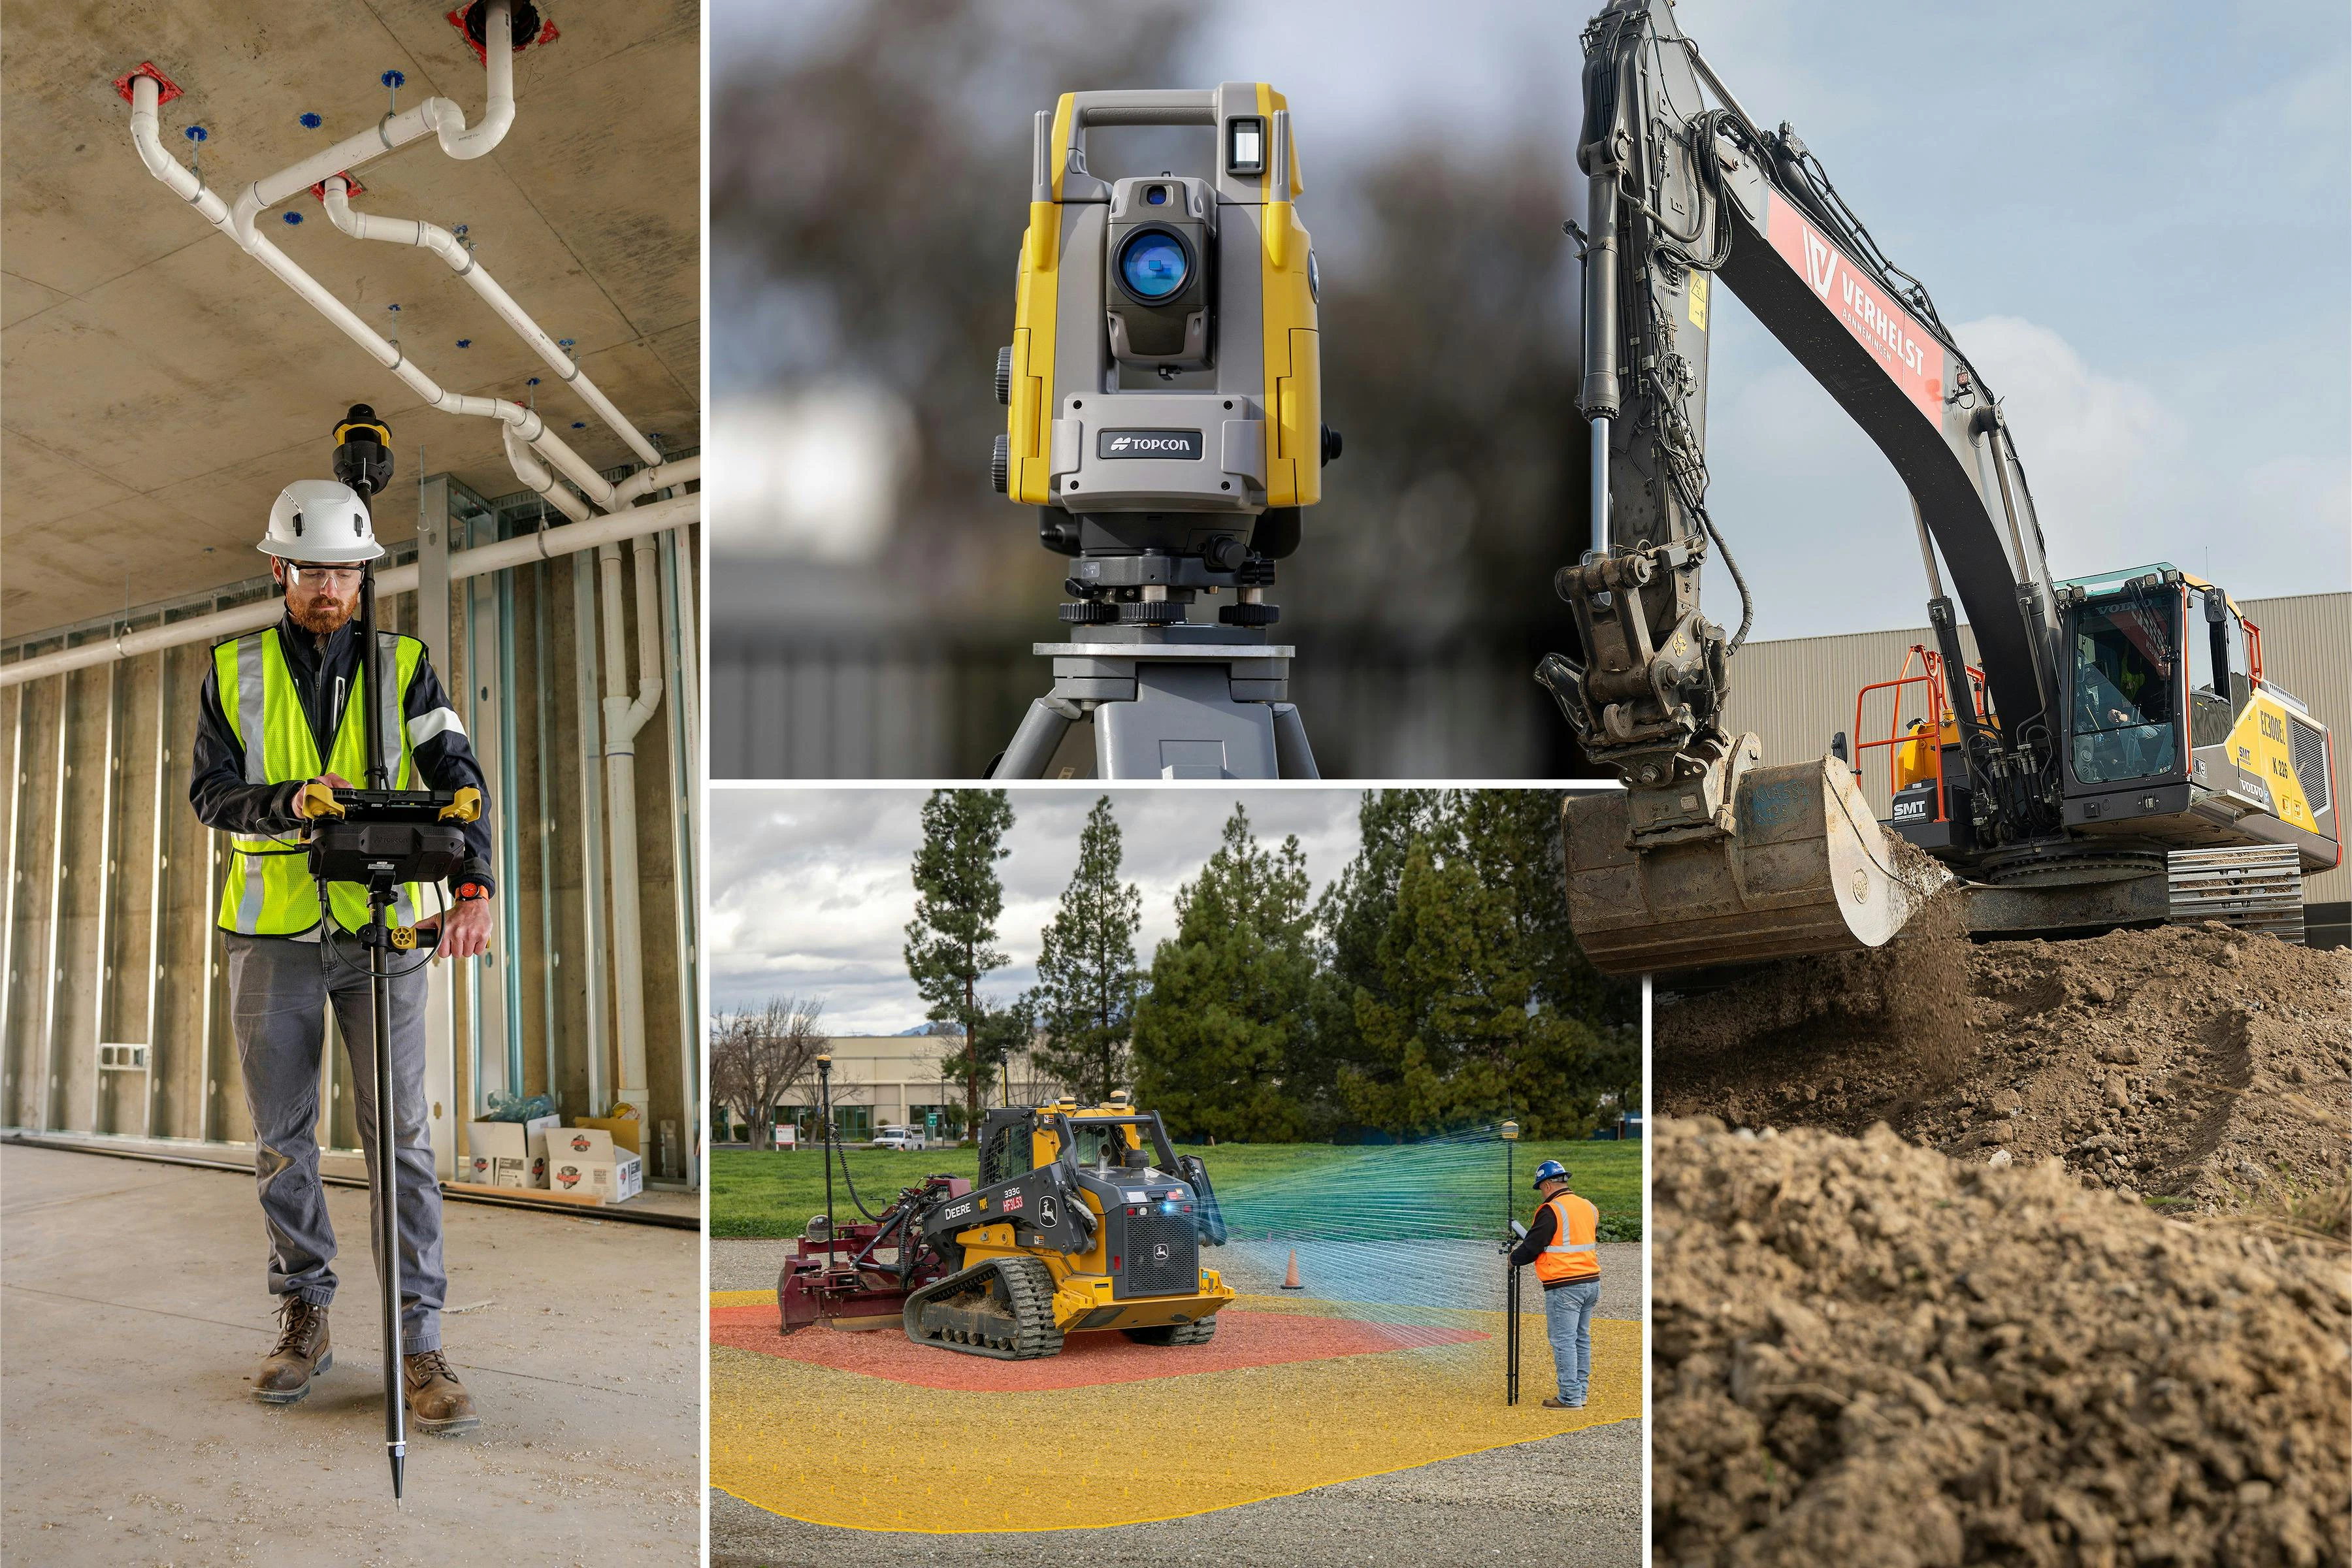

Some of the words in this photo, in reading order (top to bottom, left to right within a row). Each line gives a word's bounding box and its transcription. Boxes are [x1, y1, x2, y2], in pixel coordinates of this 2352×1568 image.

[1842, 270, 1924, 377] VERHELST
[1842, 307, 1891, 364] AANNEMINGEN
[1132, 439, 1190, 451] TOPCON
[2239, 746, 2250, 761] SMT
[2272, 757, 2278, 775] K
[2278, 760, 2288, 779] 226
[2240, 779, 2264, 798] VOLVO
[1893, 800, 1925, 817] SMT
[1004, 1186, 1020, 1198] 333G
[945, 1202, 972, 1220] DEERE
[1003, 1196, 1023, 1213] HF3L53
